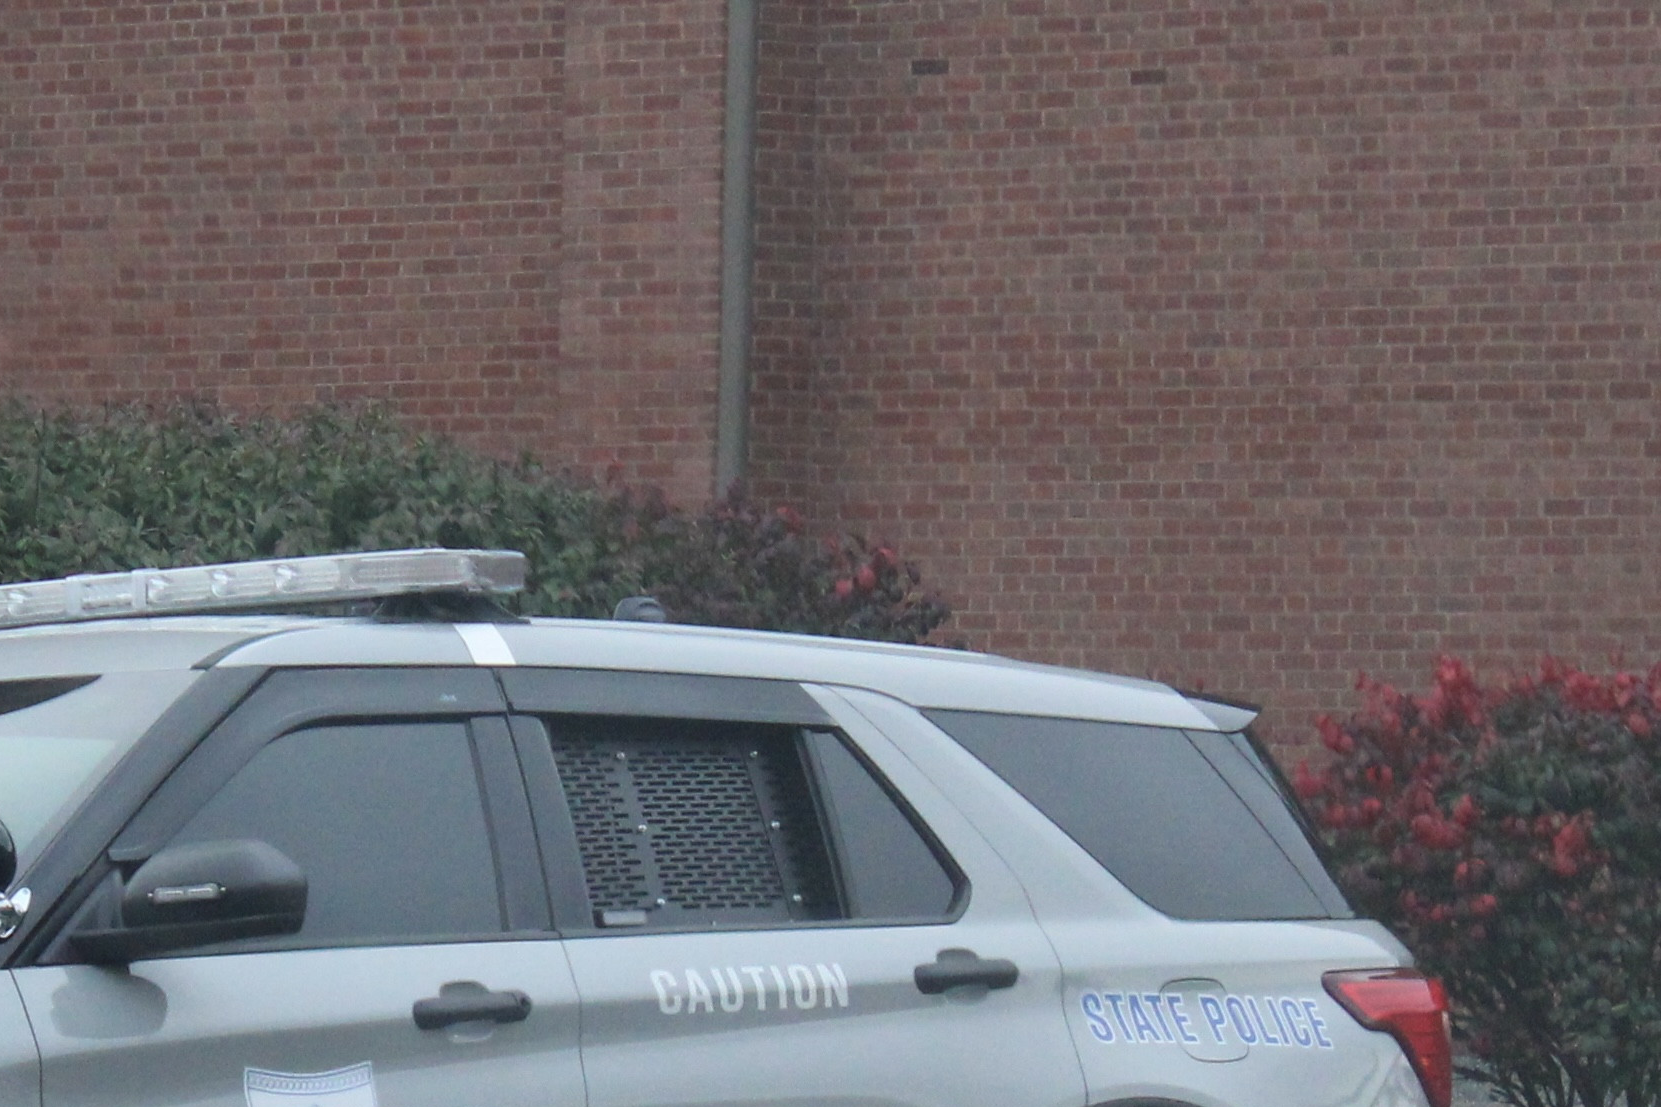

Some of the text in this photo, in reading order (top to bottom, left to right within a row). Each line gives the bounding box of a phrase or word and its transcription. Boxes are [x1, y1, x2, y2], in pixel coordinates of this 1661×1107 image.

[650, 963, 849, 1015] CAUTION
[1081, 990, 1333, 1049] STATE POLICE
